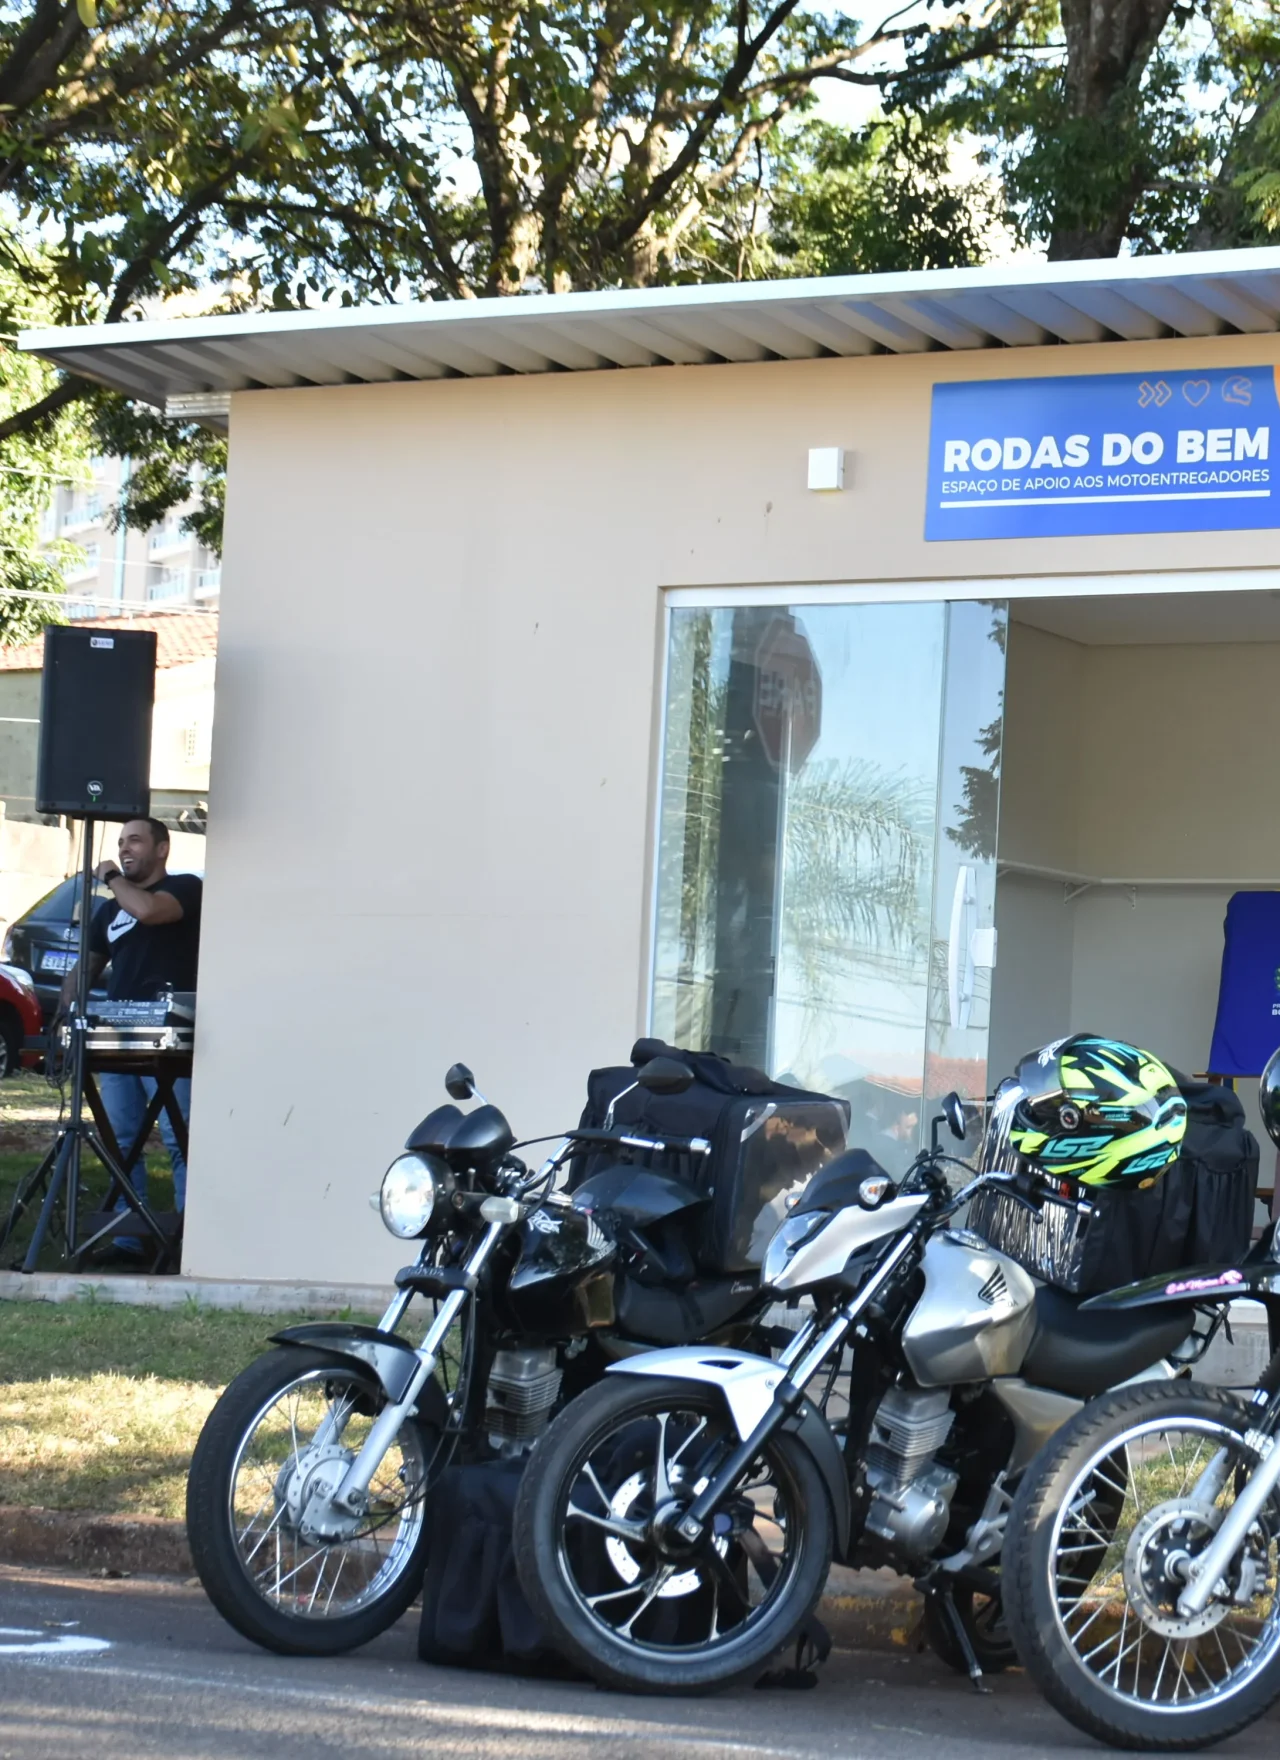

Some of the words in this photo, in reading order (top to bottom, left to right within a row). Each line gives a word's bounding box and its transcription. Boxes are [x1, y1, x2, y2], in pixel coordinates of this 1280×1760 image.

[943, 434, 1091, 472] RODAS
[1102, 431, 1164, 466] DO
[1176, 427, 1270, 463] BEM
[942, 479, 998, 495] ESPAÇO
[1001, 478, 1021, 491] DE
[1024, 476, 1071, 491] APOIO
[1074, 475, 1104, 488] AOS
[1107, 469, 1270, 487] MOTOENTREGADORES
[1039, 1135, 1114, 1158] LS2
